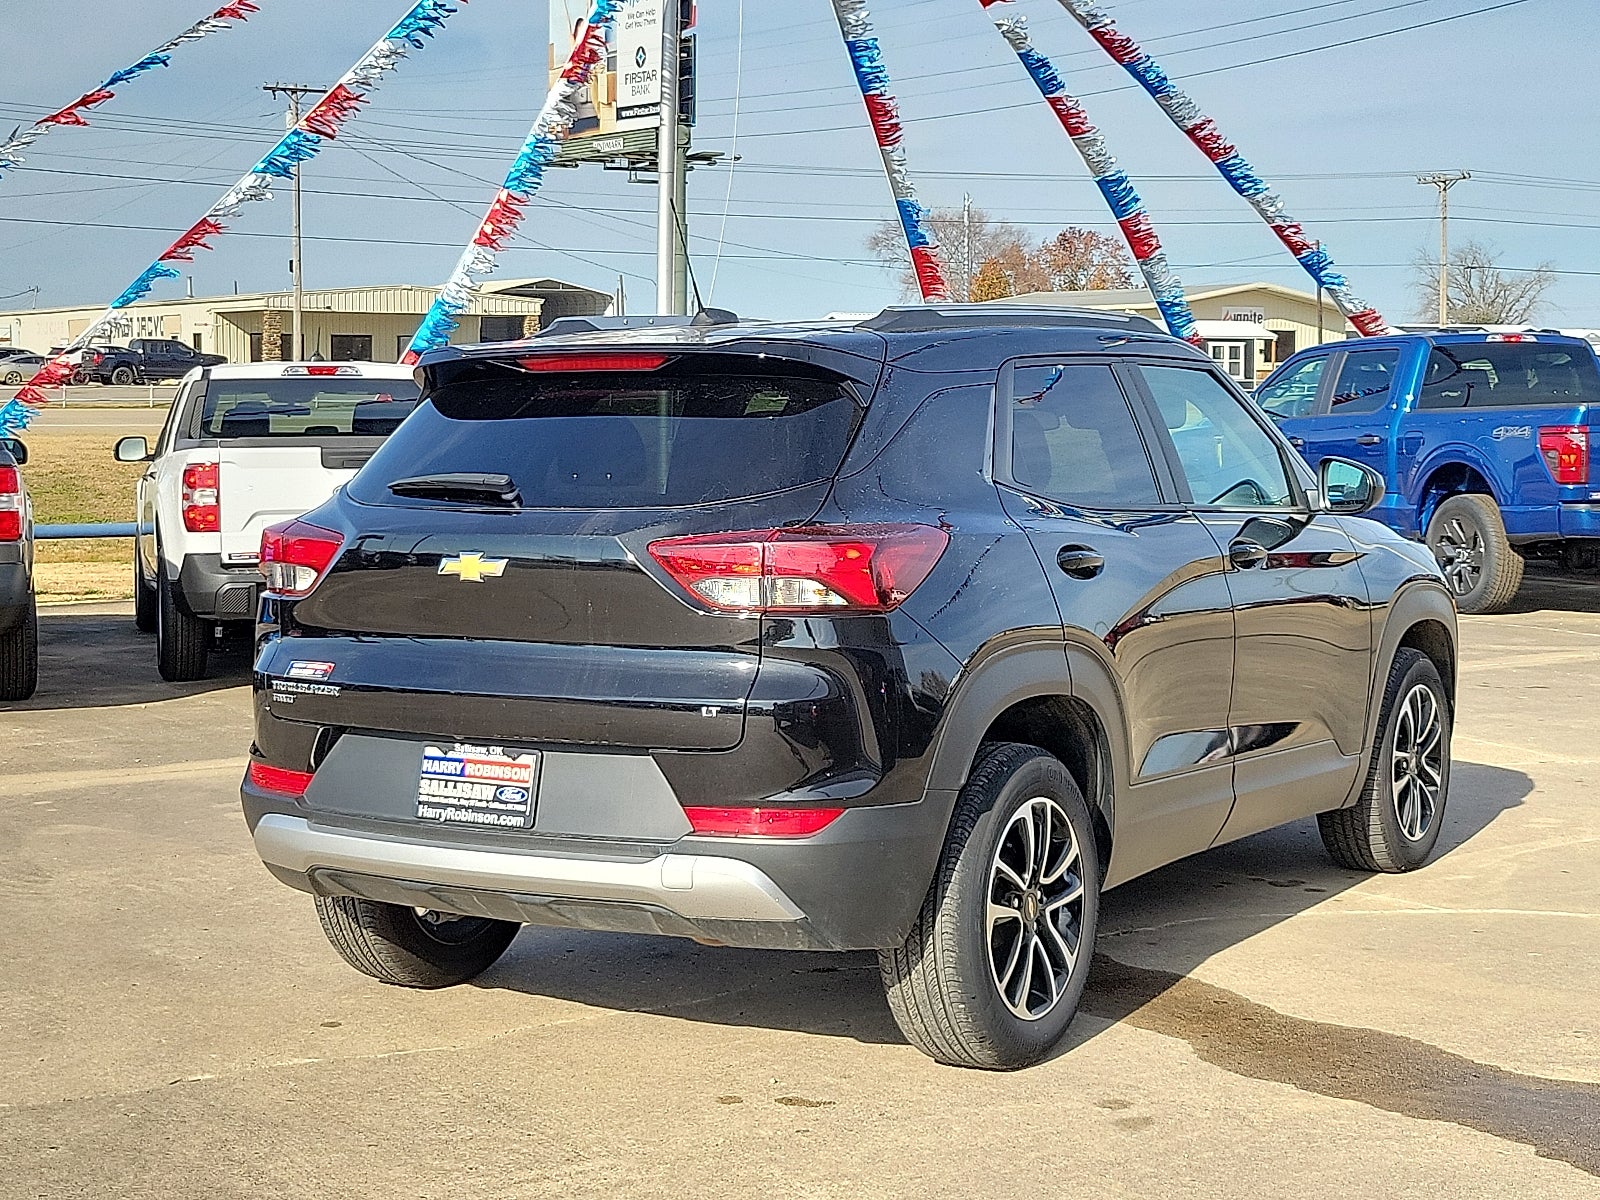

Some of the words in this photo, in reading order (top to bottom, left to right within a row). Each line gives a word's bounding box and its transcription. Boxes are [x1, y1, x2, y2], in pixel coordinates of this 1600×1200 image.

[624, 69, 658, 86] FIRSTAR
[631, 84, 651, 97] BANK
[701, 706, 721, 717] LT
[422, 759, 464, 775] HARRY
[465, 763, 531, 781] ROBINSON
[419, 779, 497, 800] SALLISAW
[418, 804, 525, 827] HarryRobinson.com
